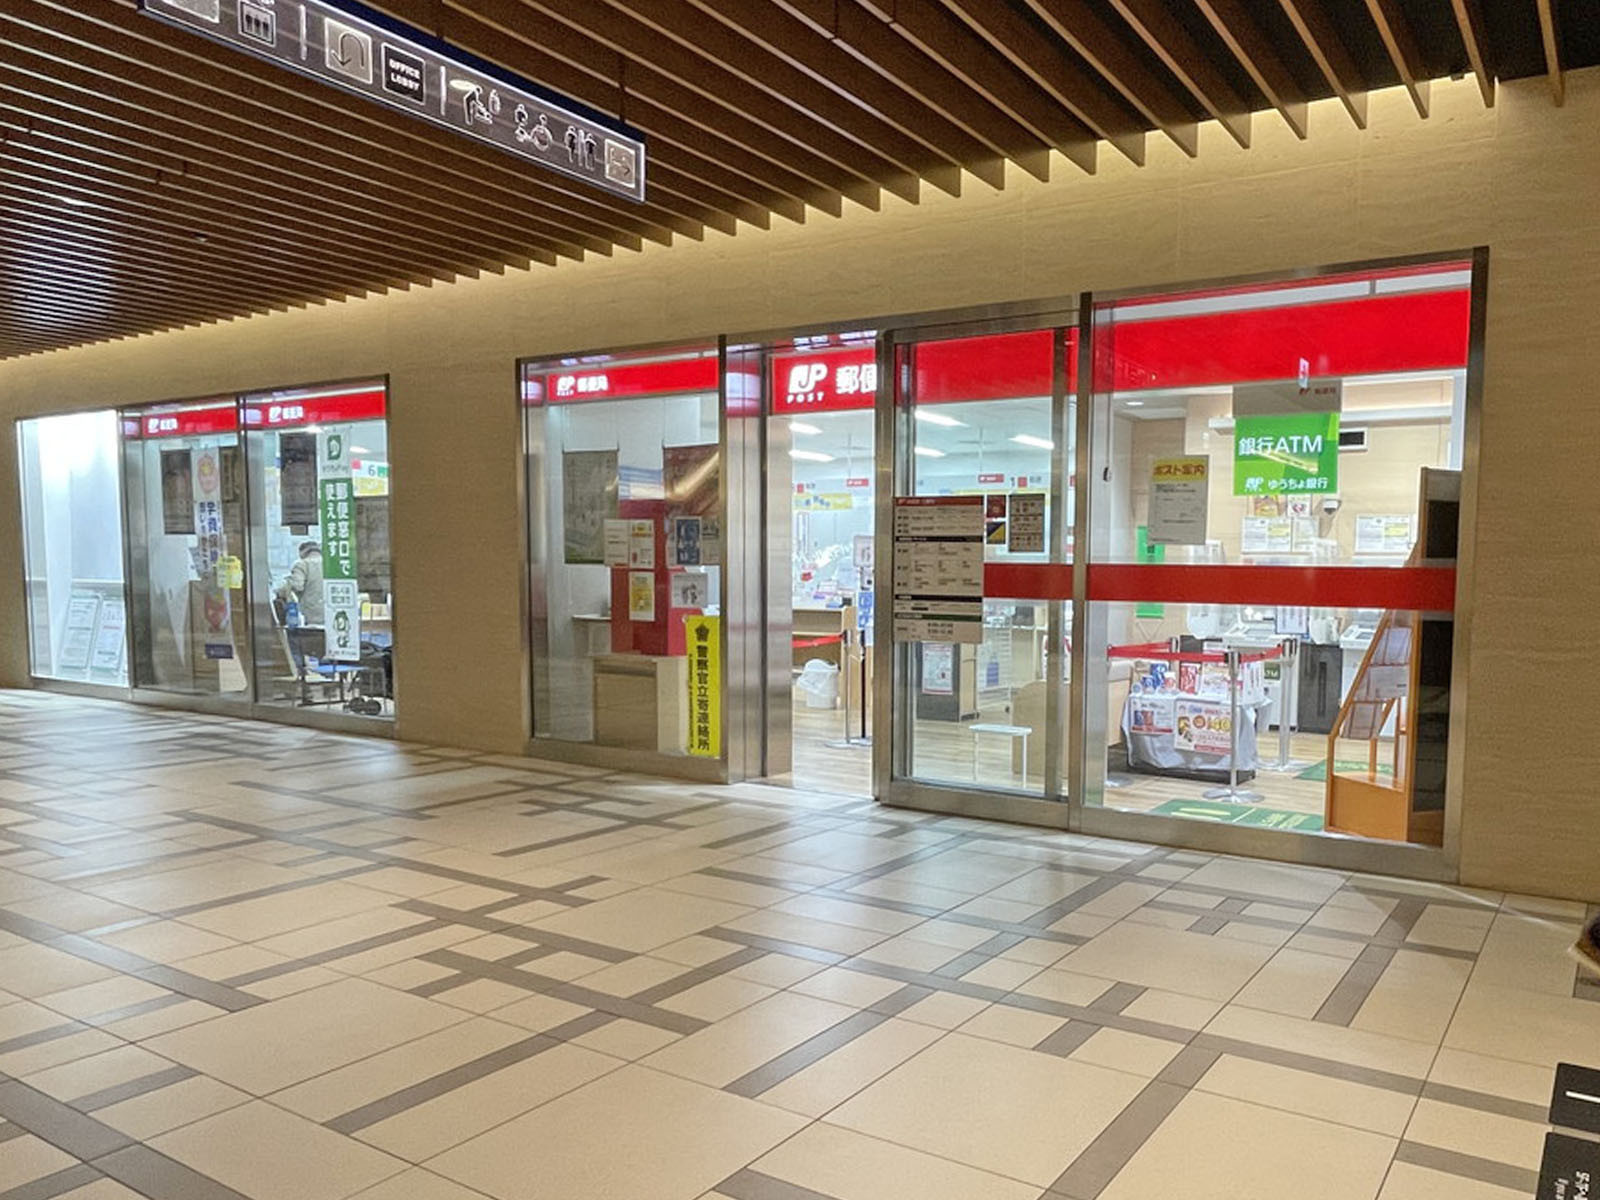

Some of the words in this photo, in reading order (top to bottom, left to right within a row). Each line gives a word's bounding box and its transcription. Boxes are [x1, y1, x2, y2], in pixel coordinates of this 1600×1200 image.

[389, 58, 421, 80] OFFICE
[390, 72, 420, 90] LOBBY
[787, 391, 824, 404] POST
[1238, 434, 1323, 456] 銀行ATM
[1267, 477, 1328, 490] ゆうちょ銀行
[325, 483, 337, 557] 使えます
[335, 482, 351, 576] 郵便窓口で
